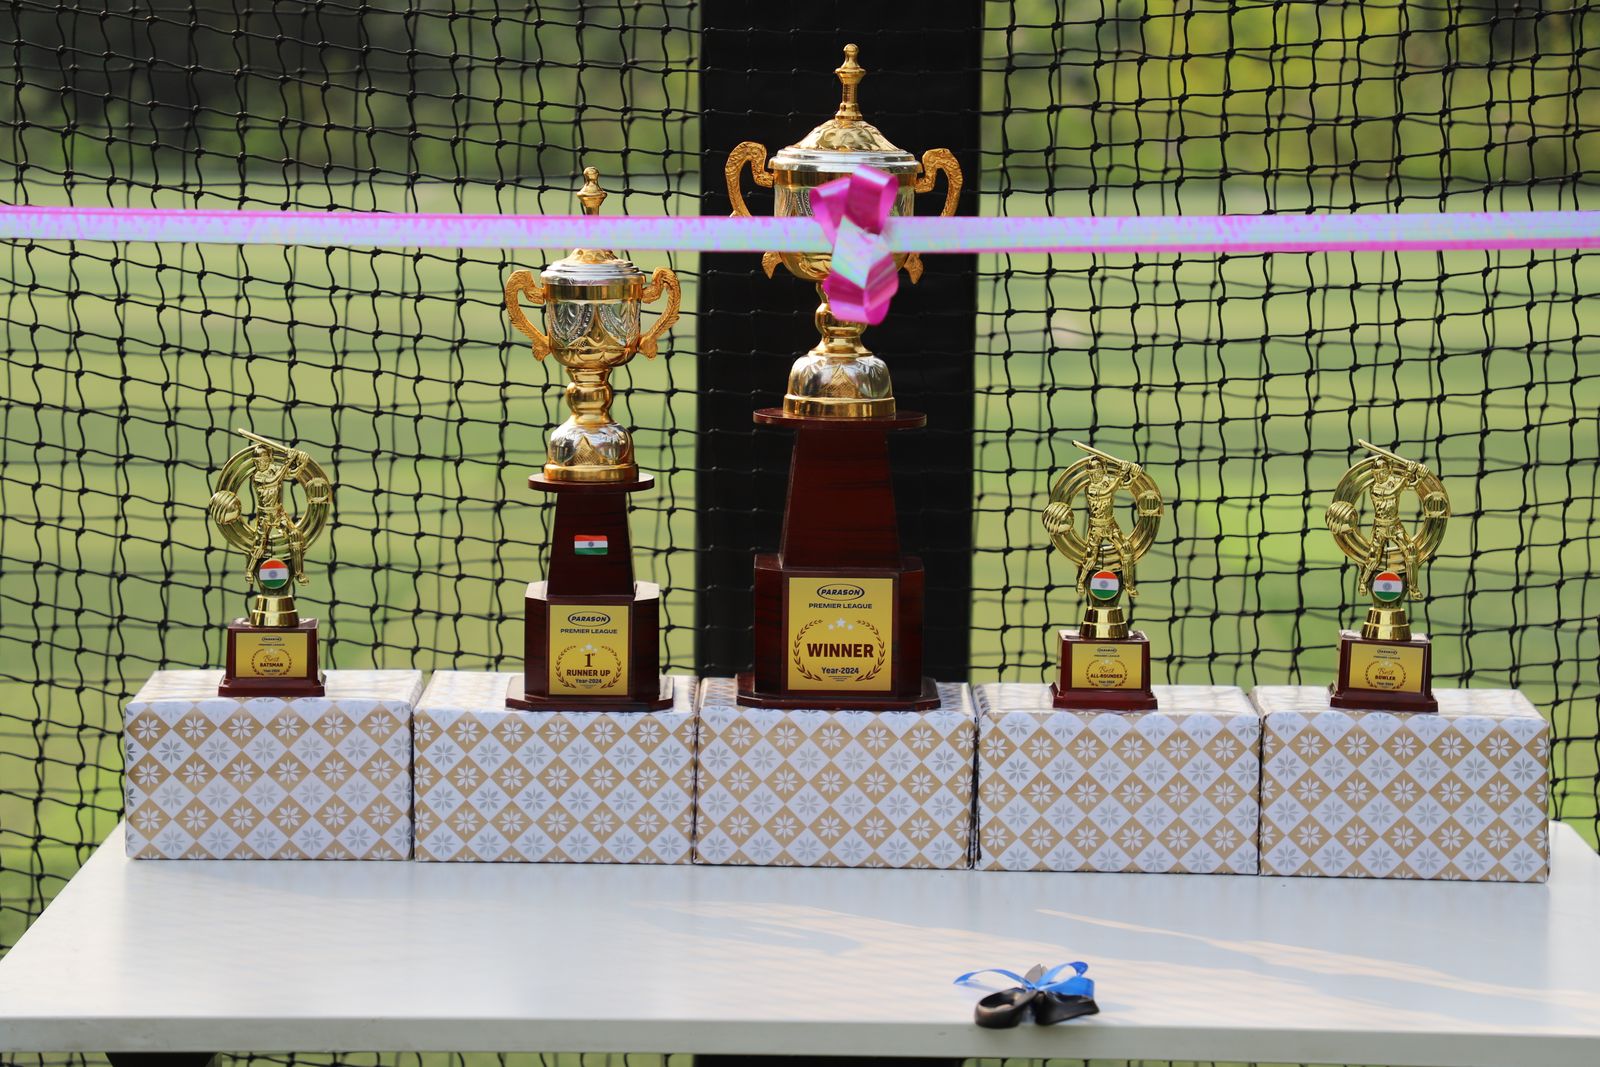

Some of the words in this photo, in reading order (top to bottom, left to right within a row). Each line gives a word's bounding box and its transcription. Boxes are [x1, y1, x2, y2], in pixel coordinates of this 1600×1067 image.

[807, 643, 874, 658] WINNER
[566, 669, 598, 677] RUNNER
[599, 669, 611, 677] UP
[821, 667, 860, 675] Year-2024
